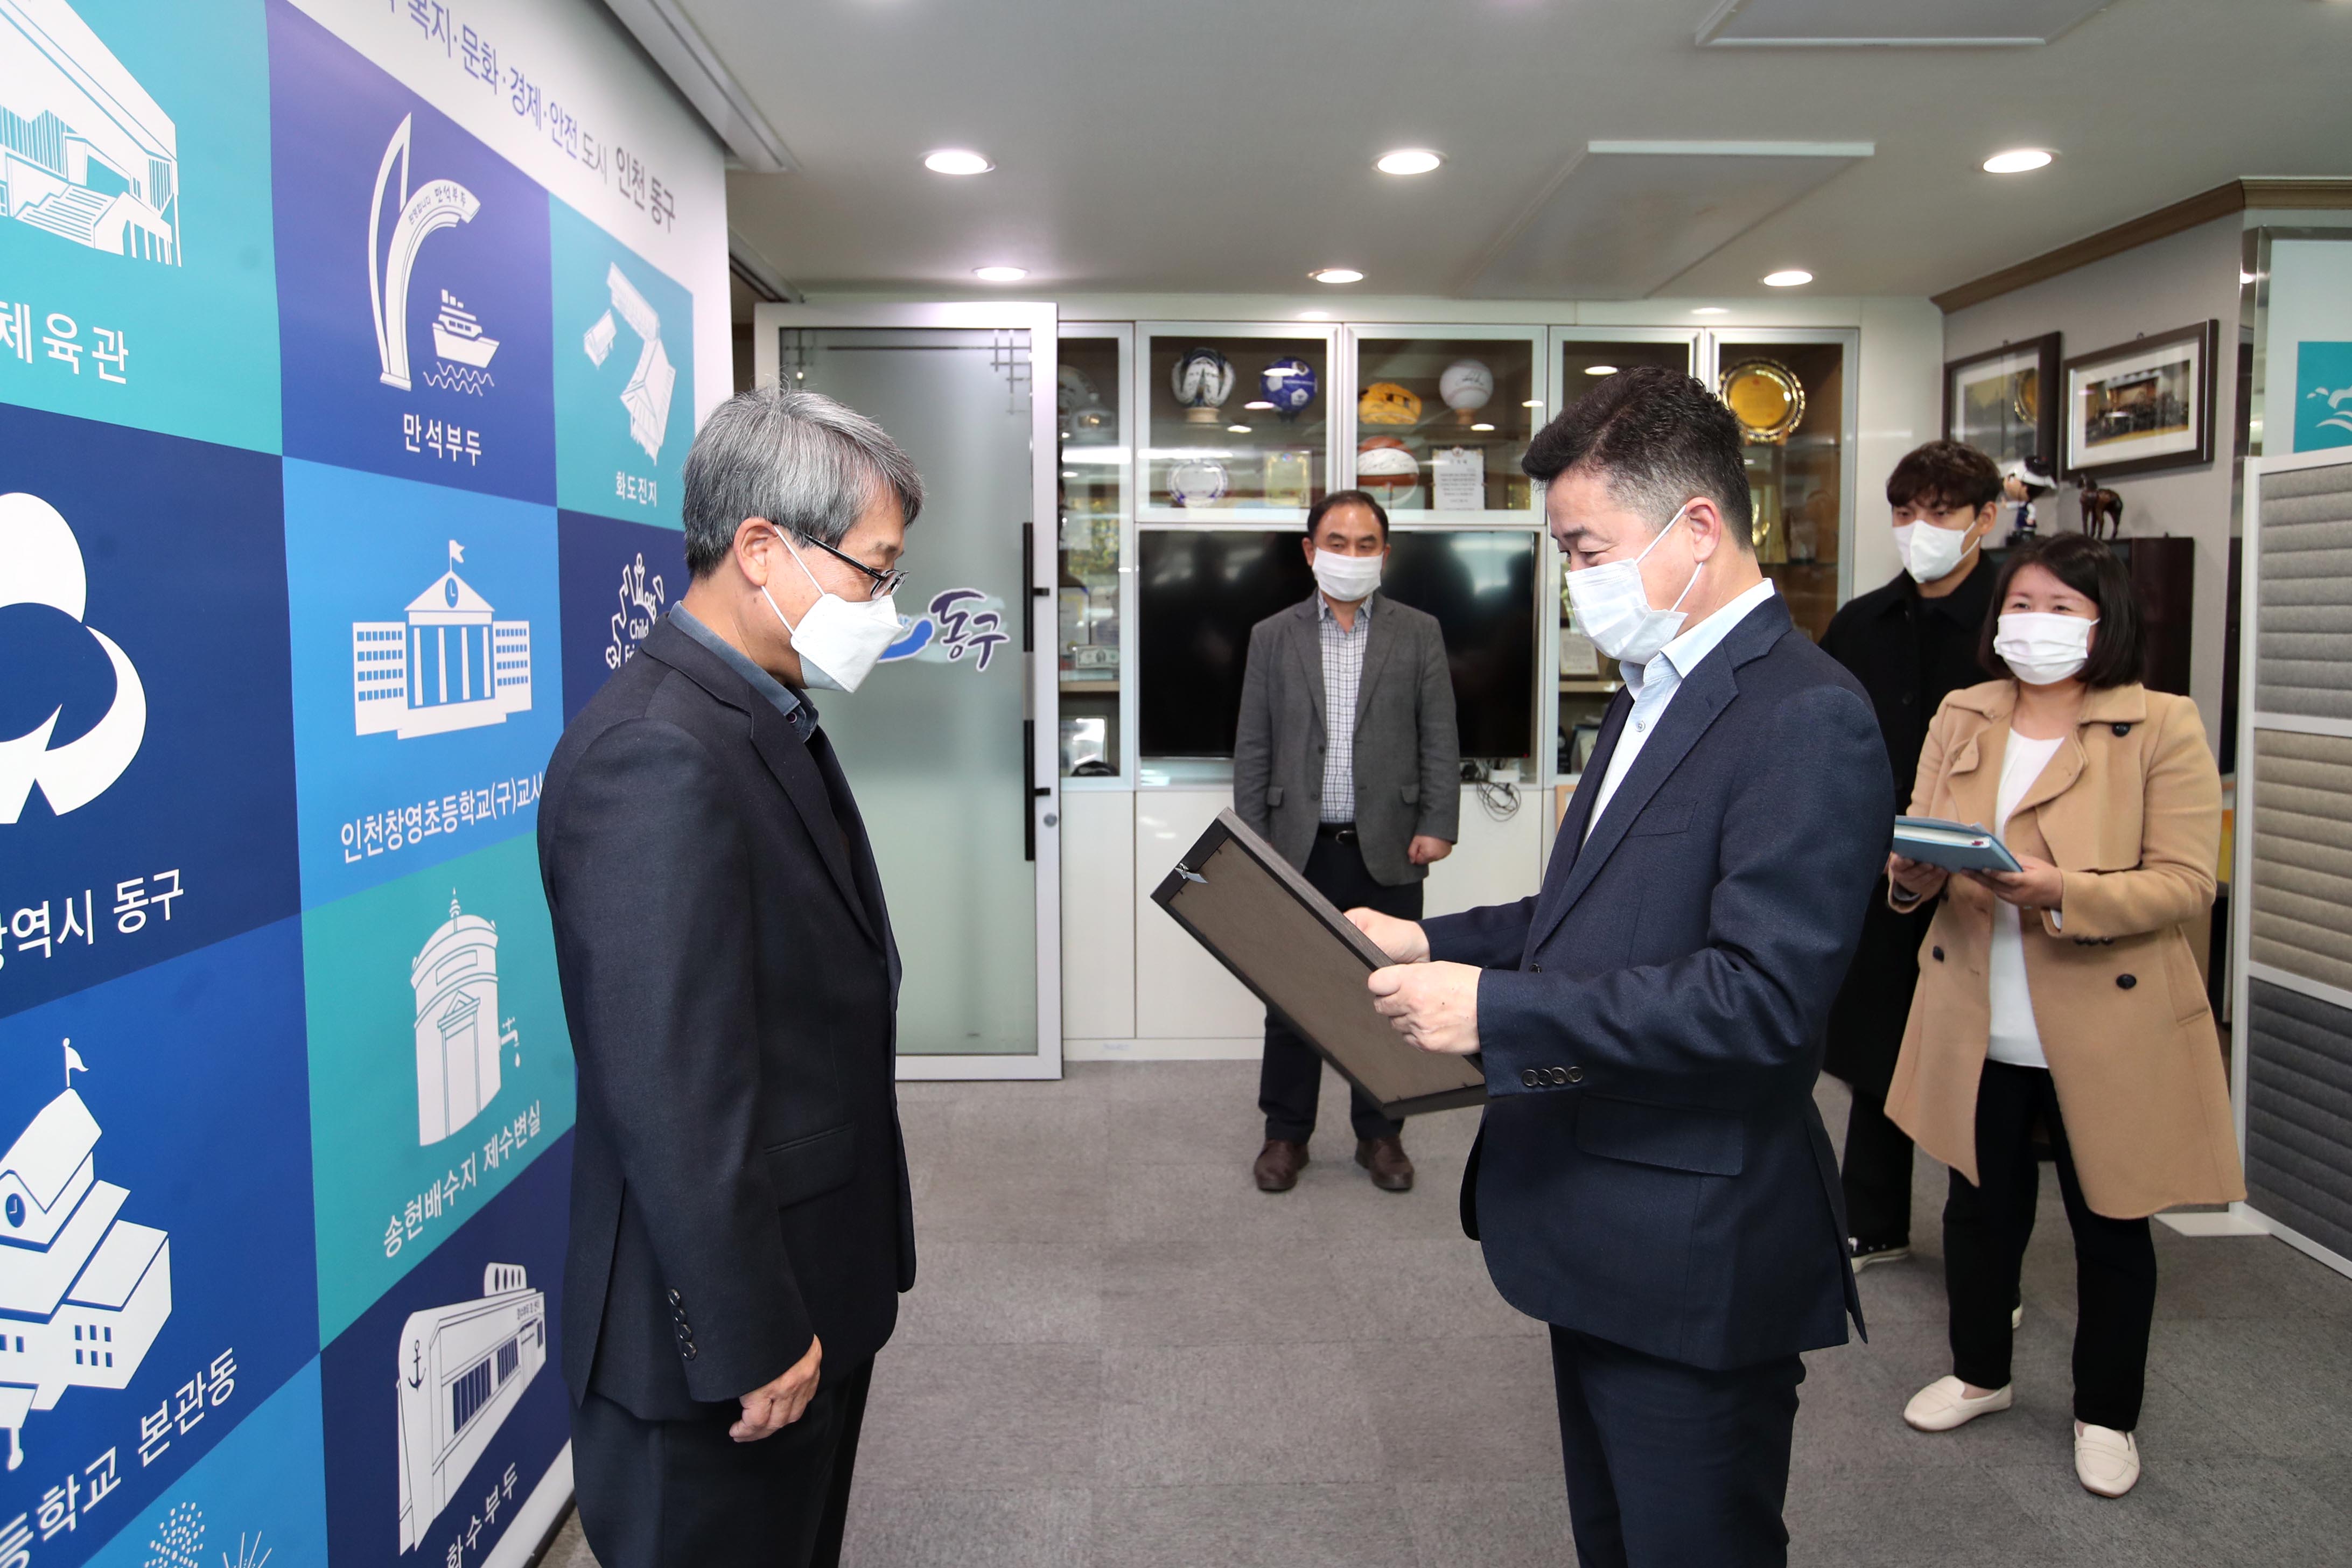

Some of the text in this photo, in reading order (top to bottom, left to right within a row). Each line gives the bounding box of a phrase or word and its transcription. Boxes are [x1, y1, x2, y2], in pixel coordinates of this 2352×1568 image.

[582, 132, 607, 185] 도시
[617, 146, 645, 211] 인천
[650, 176, 675, 234] 동구
[403, 413, 482, 466] 만석부두
[616, 471, 657, 508] 화도진지
[629, 618, 649, 641] Child
[930, 591, 1009, 669] 동구
[341, 771, 543, 863] 인천창영초등학교(구)교사
[0, 869, 184, 971] 역시 동구
[384, 1100, 540, 1258] 송현배수지 제수변실
[138, 1347, 237, 1467] 본관동
